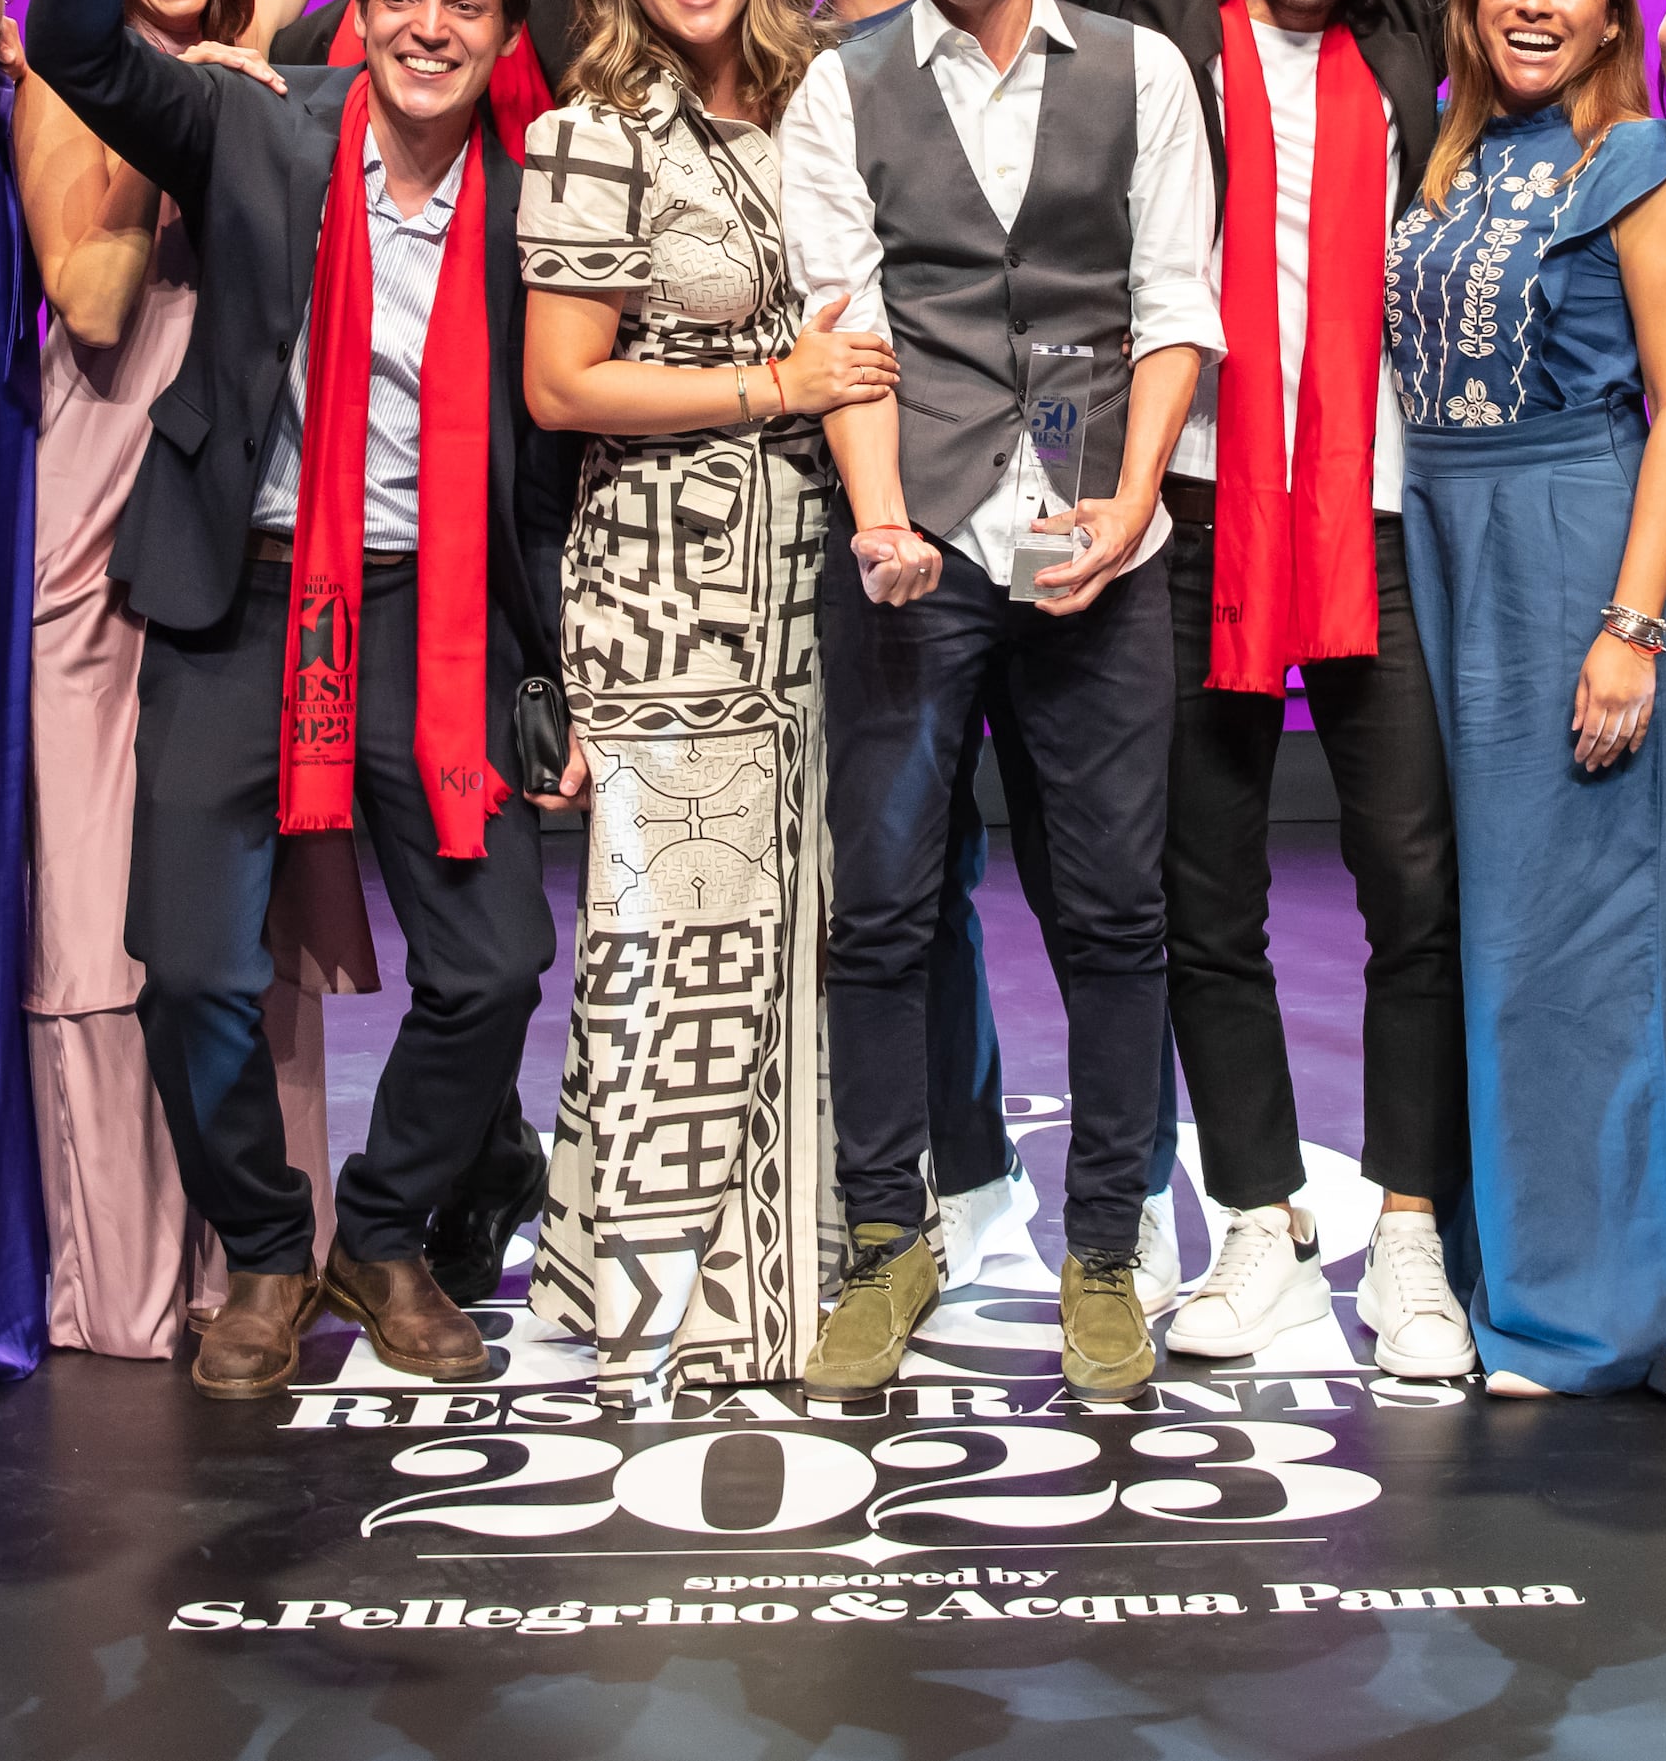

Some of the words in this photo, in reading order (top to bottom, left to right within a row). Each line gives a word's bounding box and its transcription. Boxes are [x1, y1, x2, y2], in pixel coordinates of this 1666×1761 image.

[1031, 401, 1077, 433] 50
[1215, 600, 1244, 625] tral
[296, 673, 353, 702] EST
[360, 1422, 1383, 1538] 2023
[683, 1566, 985, 1593] sponsored
[988, 1566, 1060, 1588] by
[167, 1597, 800, 1635] S.Pellegrino
[810, 1591, 909, 1623] &
[915, 1589, 1250, 1624] Acqua
[1261, 1581, 1587, 1614] Panna
